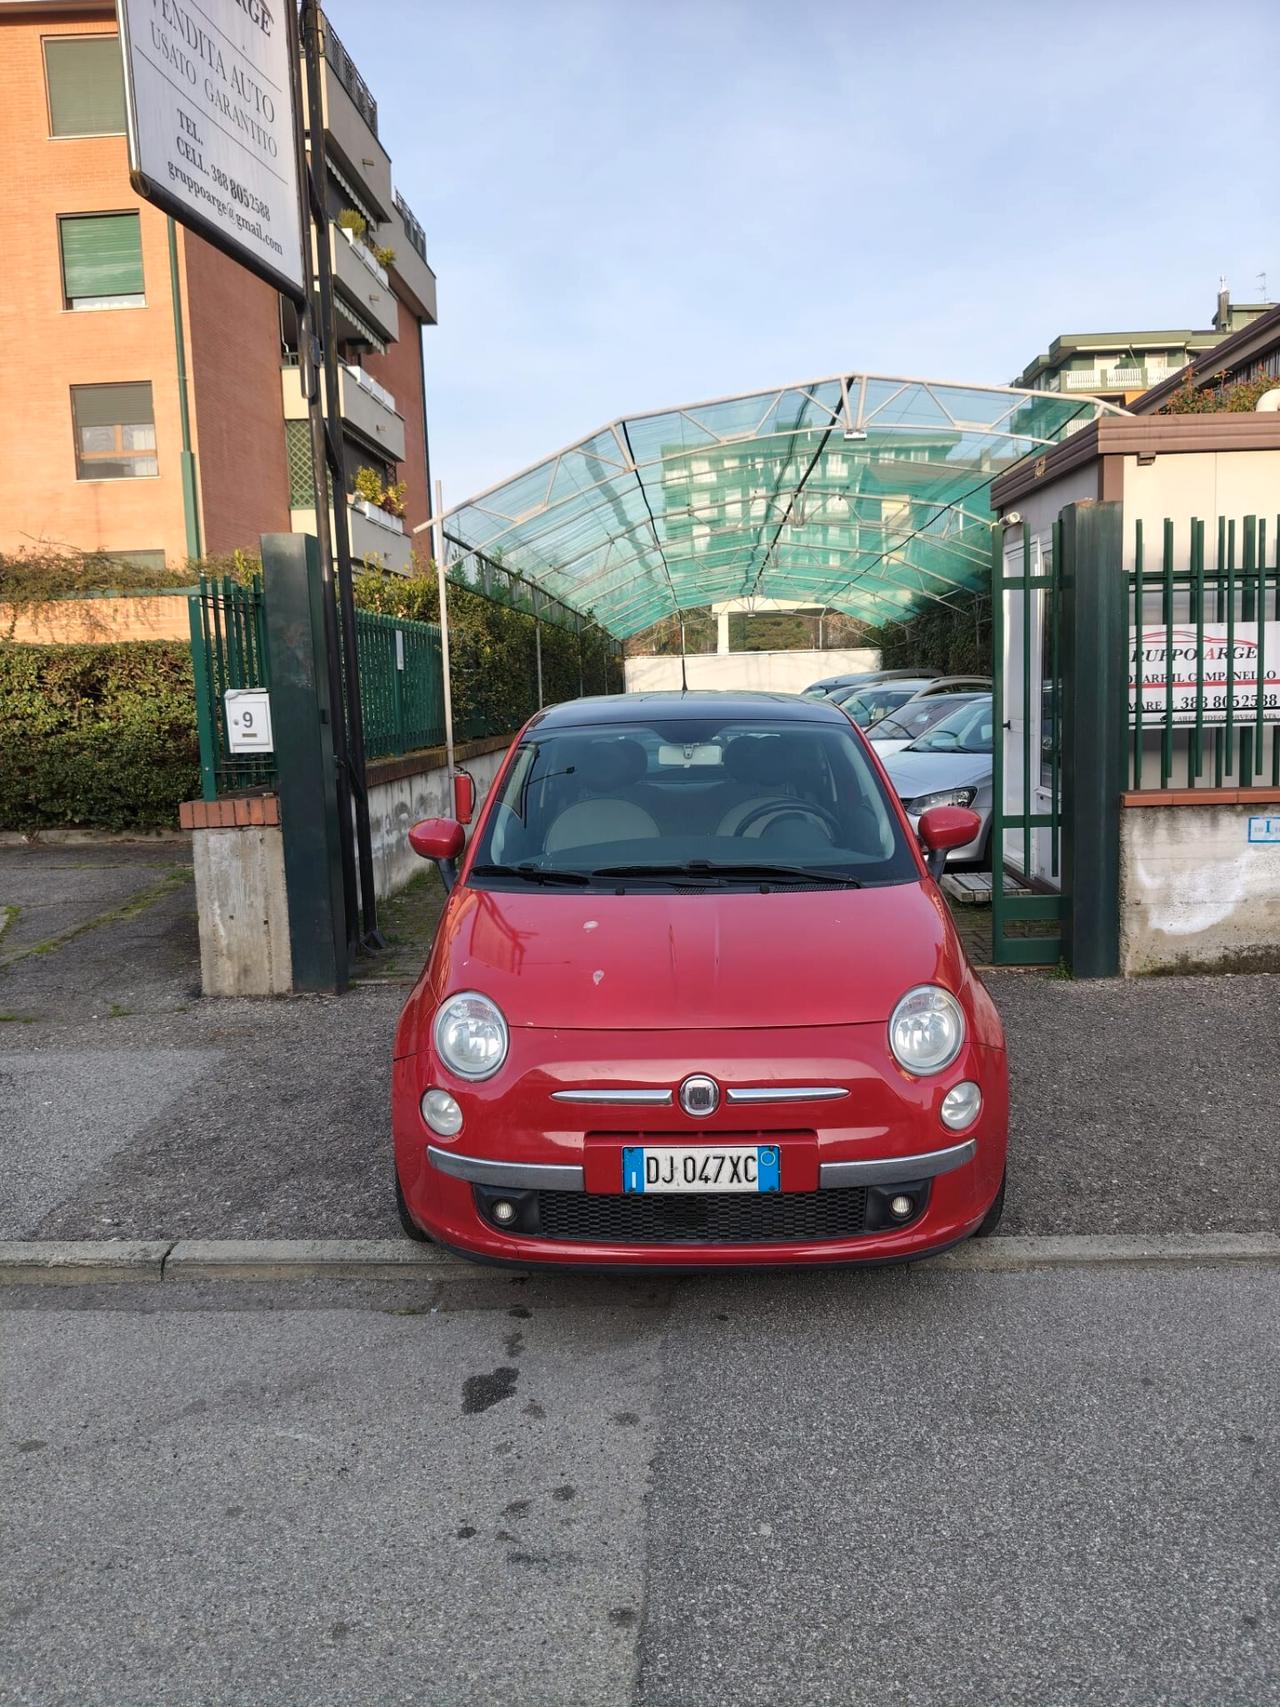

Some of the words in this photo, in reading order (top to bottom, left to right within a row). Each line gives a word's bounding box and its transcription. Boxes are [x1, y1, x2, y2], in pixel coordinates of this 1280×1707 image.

[153, 0, 227, 81] ENDITA
[231, 65, 275, 123] AUTO
[150, 20, 197, 85] USATO
[204, 78, 277, 158] GARANTITO
[177, 109, 203, 145] TEL.
[176, 136, 209, 176] CELL.
[167, 161, 283, 255] gruppoarge@gmail.com
[1188, 671, 1276, 682] CMPNELO
[243, 711, 253, 728] 9
